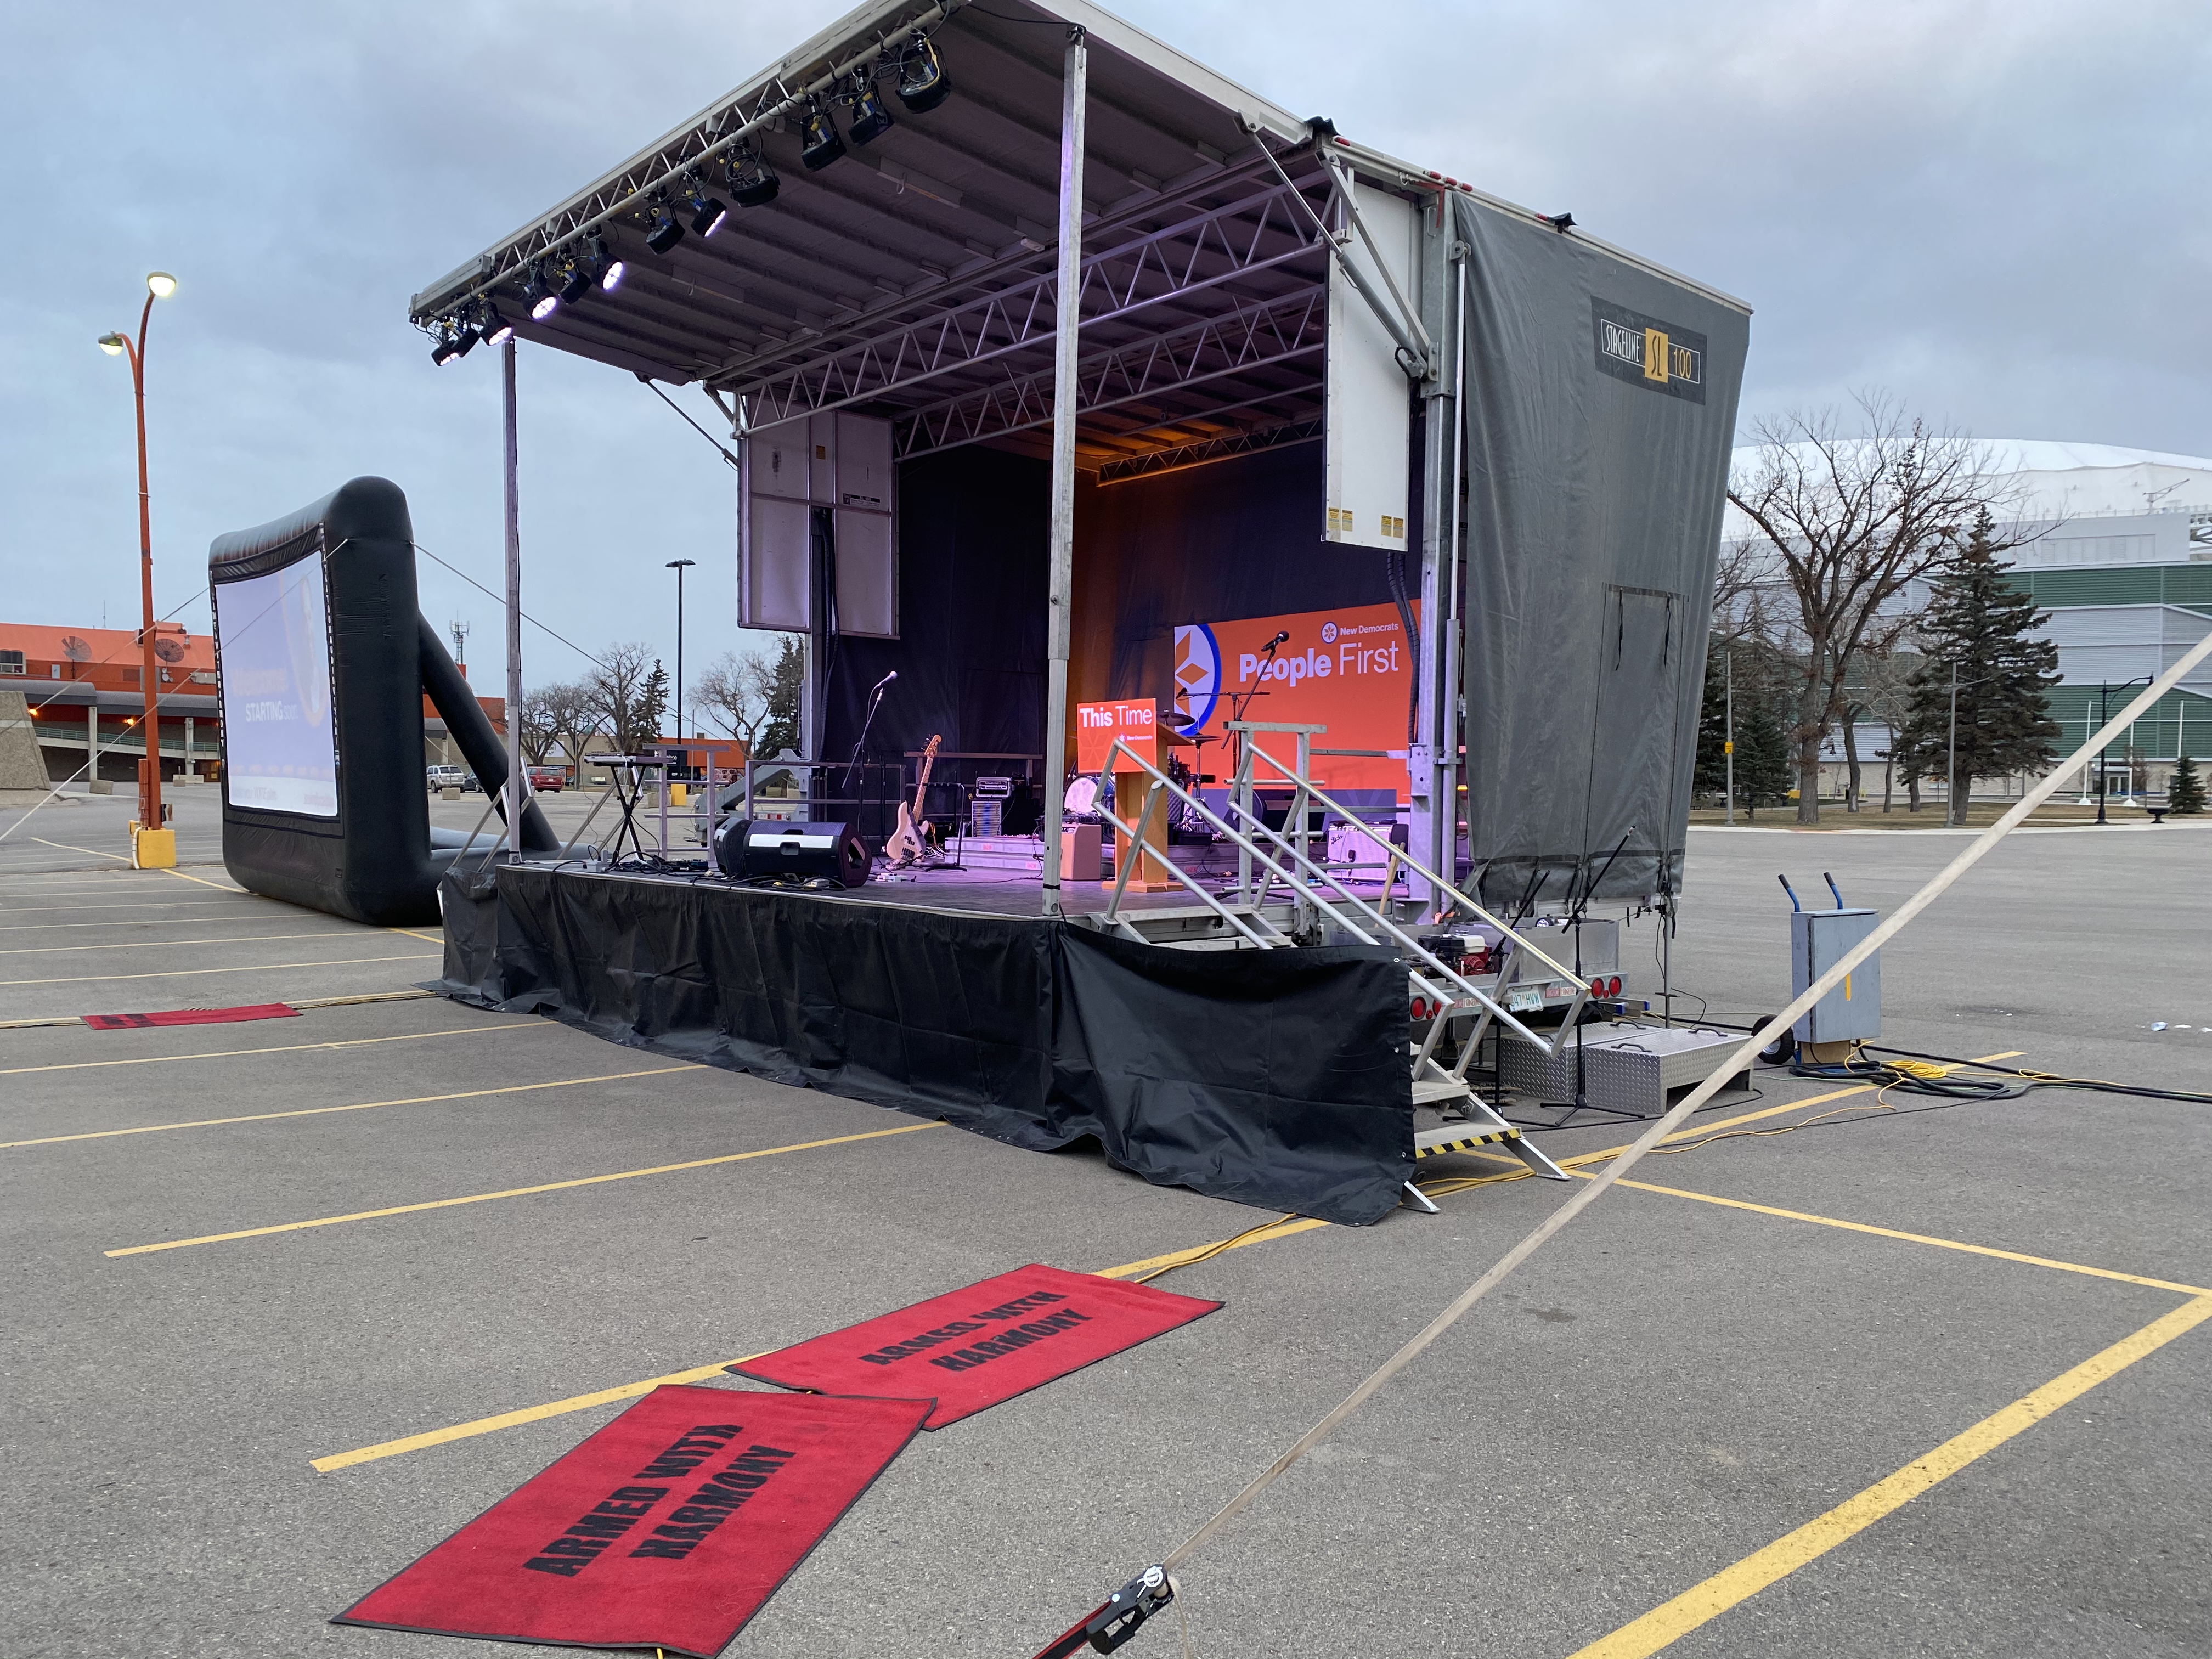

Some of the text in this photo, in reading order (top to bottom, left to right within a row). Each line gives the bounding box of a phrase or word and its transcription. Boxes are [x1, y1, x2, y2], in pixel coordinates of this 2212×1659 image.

[1606, 324, 1692, 379] STAGELINE SL 100
[1340, 622, 1399, 636] New Democrats
[1240, 640, 1399, 687] People First
[246, 701, 283, 722] STARTING
[1080, 705, 1153, 728] This Time
[1525, 992, 1540, 1005] HVW
[857, 1291, 1069, 1365] ARMED WITH
[928, 1308, 1093, 1372] HARMONY
[523, 1424, 744, 1577] ARMED WITH
[628, 1445, 797, 1559] HARMONY
